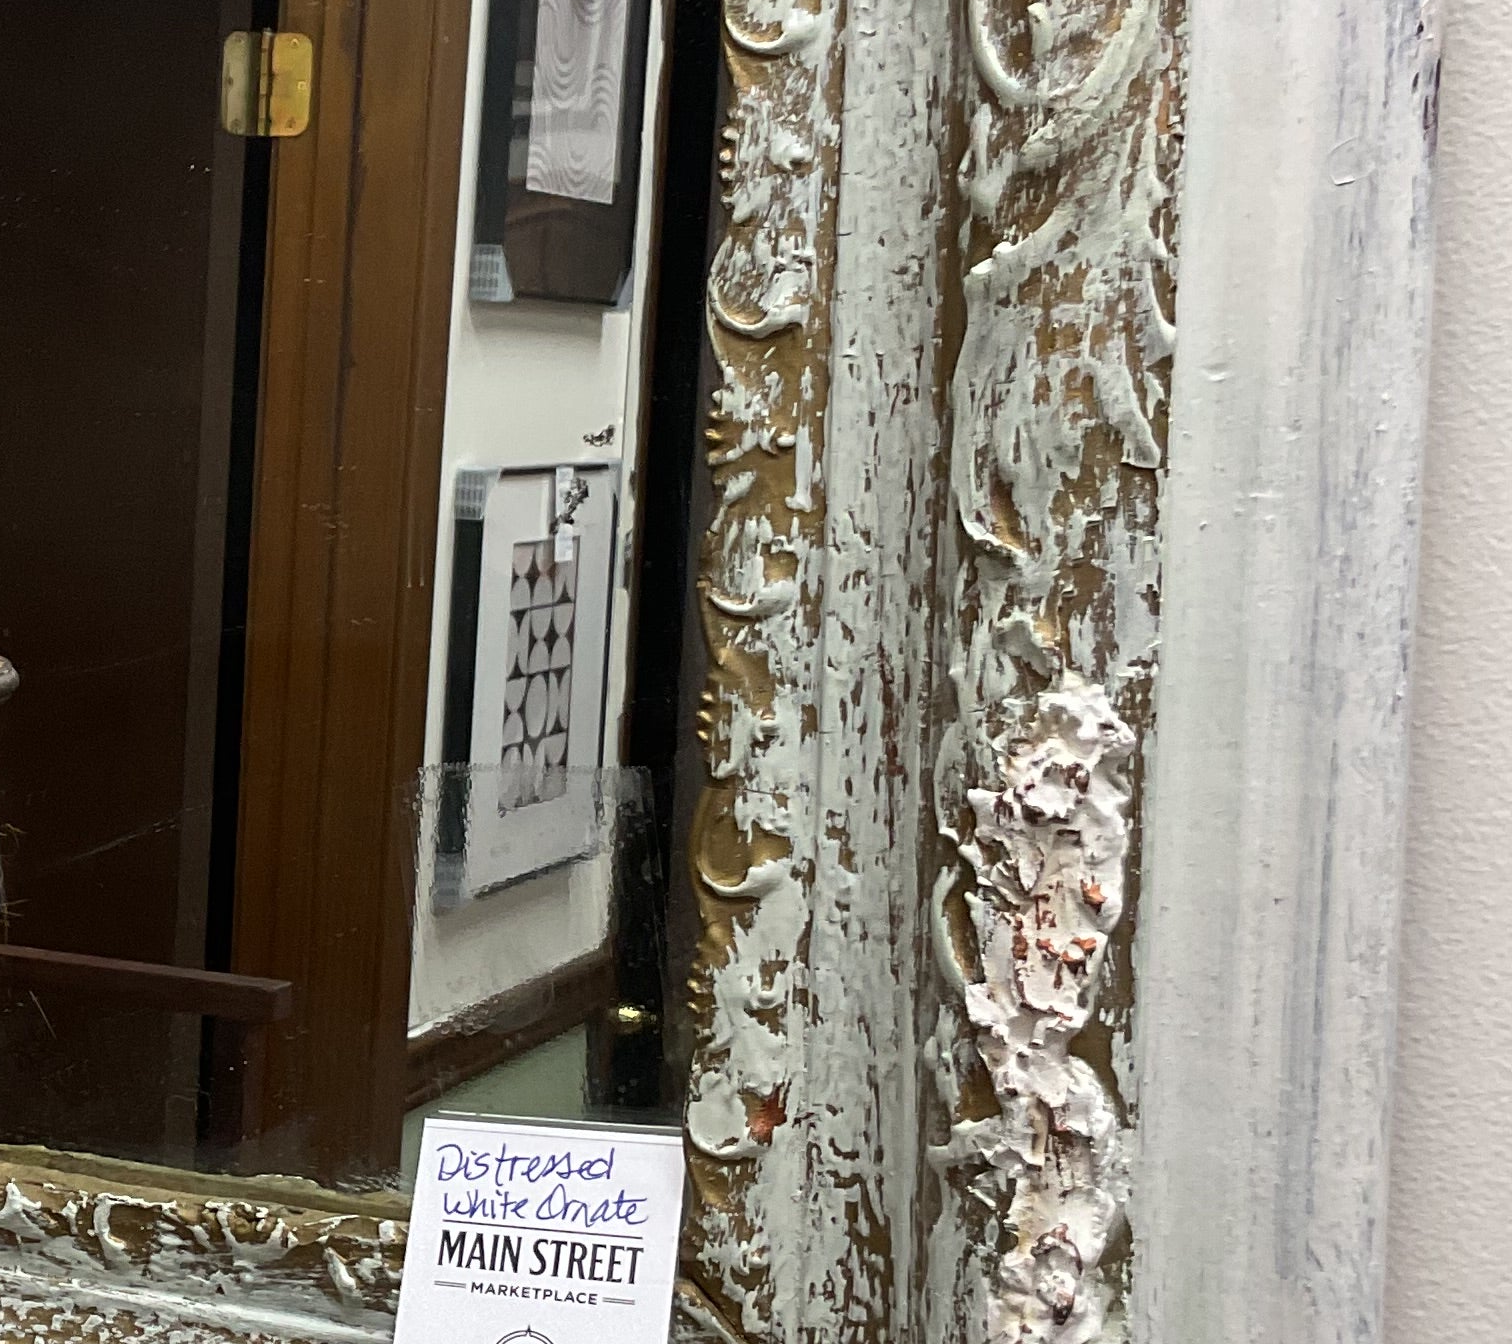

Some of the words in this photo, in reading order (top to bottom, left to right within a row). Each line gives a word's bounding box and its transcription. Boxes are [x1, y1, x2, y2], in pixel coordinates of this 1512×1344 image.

[436, 1142, 615, 1187] Distressed
[536, 1183, 649, 1228] Ornate
[437, 1229, 523, 1274] MAIN
[528, 1238, 645, 1285] STREET
[470, 1281, 599, 1306] MARKETPLACE
